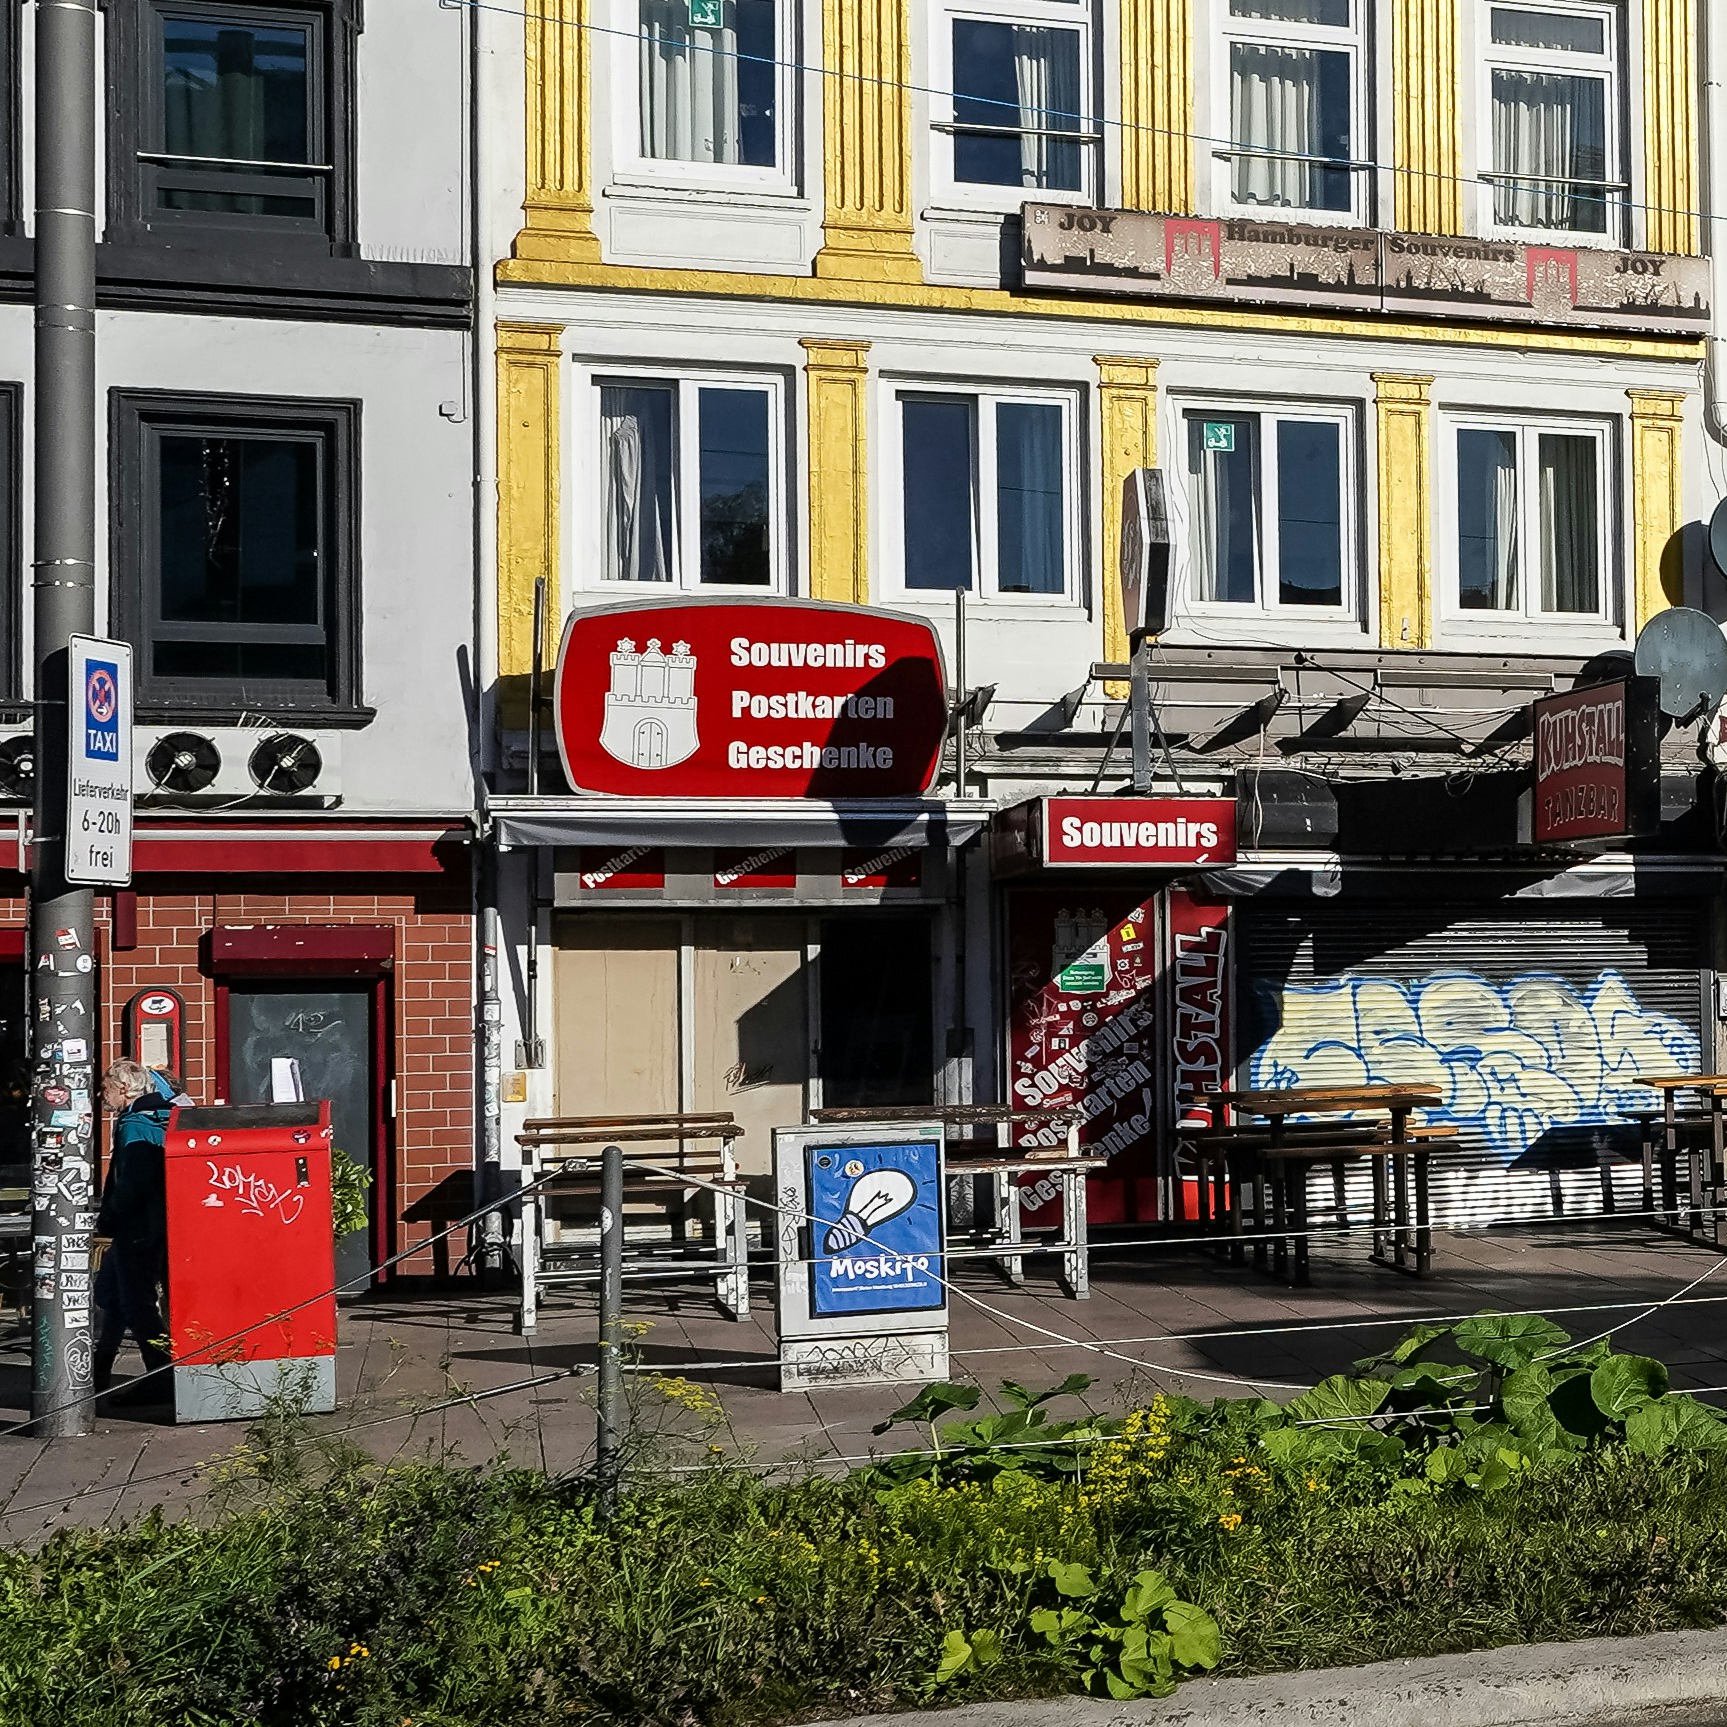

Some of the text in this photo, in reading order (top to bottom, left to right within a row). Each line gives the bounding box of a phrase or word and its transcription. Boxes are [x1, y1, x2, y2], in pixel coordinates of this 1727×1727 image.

[1058, 211, 1118, 234] JOY
[1226, 222, 1516, 263] Hamburger Souvenirs
[1615, 255, 1666, 277] JOY
[730, 637, 886, 668] Souvenirs
[731, 690, 894, 719] Postkarten
[88, 729, 117, 754] TAXI
[728, 741, 893, 769] Geschenke
[1538, 699, 1625, 783] KUHSTALL
[73, 778, 129, 802] Lieferverkehr
[1544, 783, 1619, 831] TANZBAR
[82, 809, 121, 835] 6-20h
[1061, 816, 1218, 848] Souvenirs
[89, 844, 114, 869] frei
[1018, 1059, 1152, 1148] Poskarten
[830, 1254, 929, 1283] Moskito
